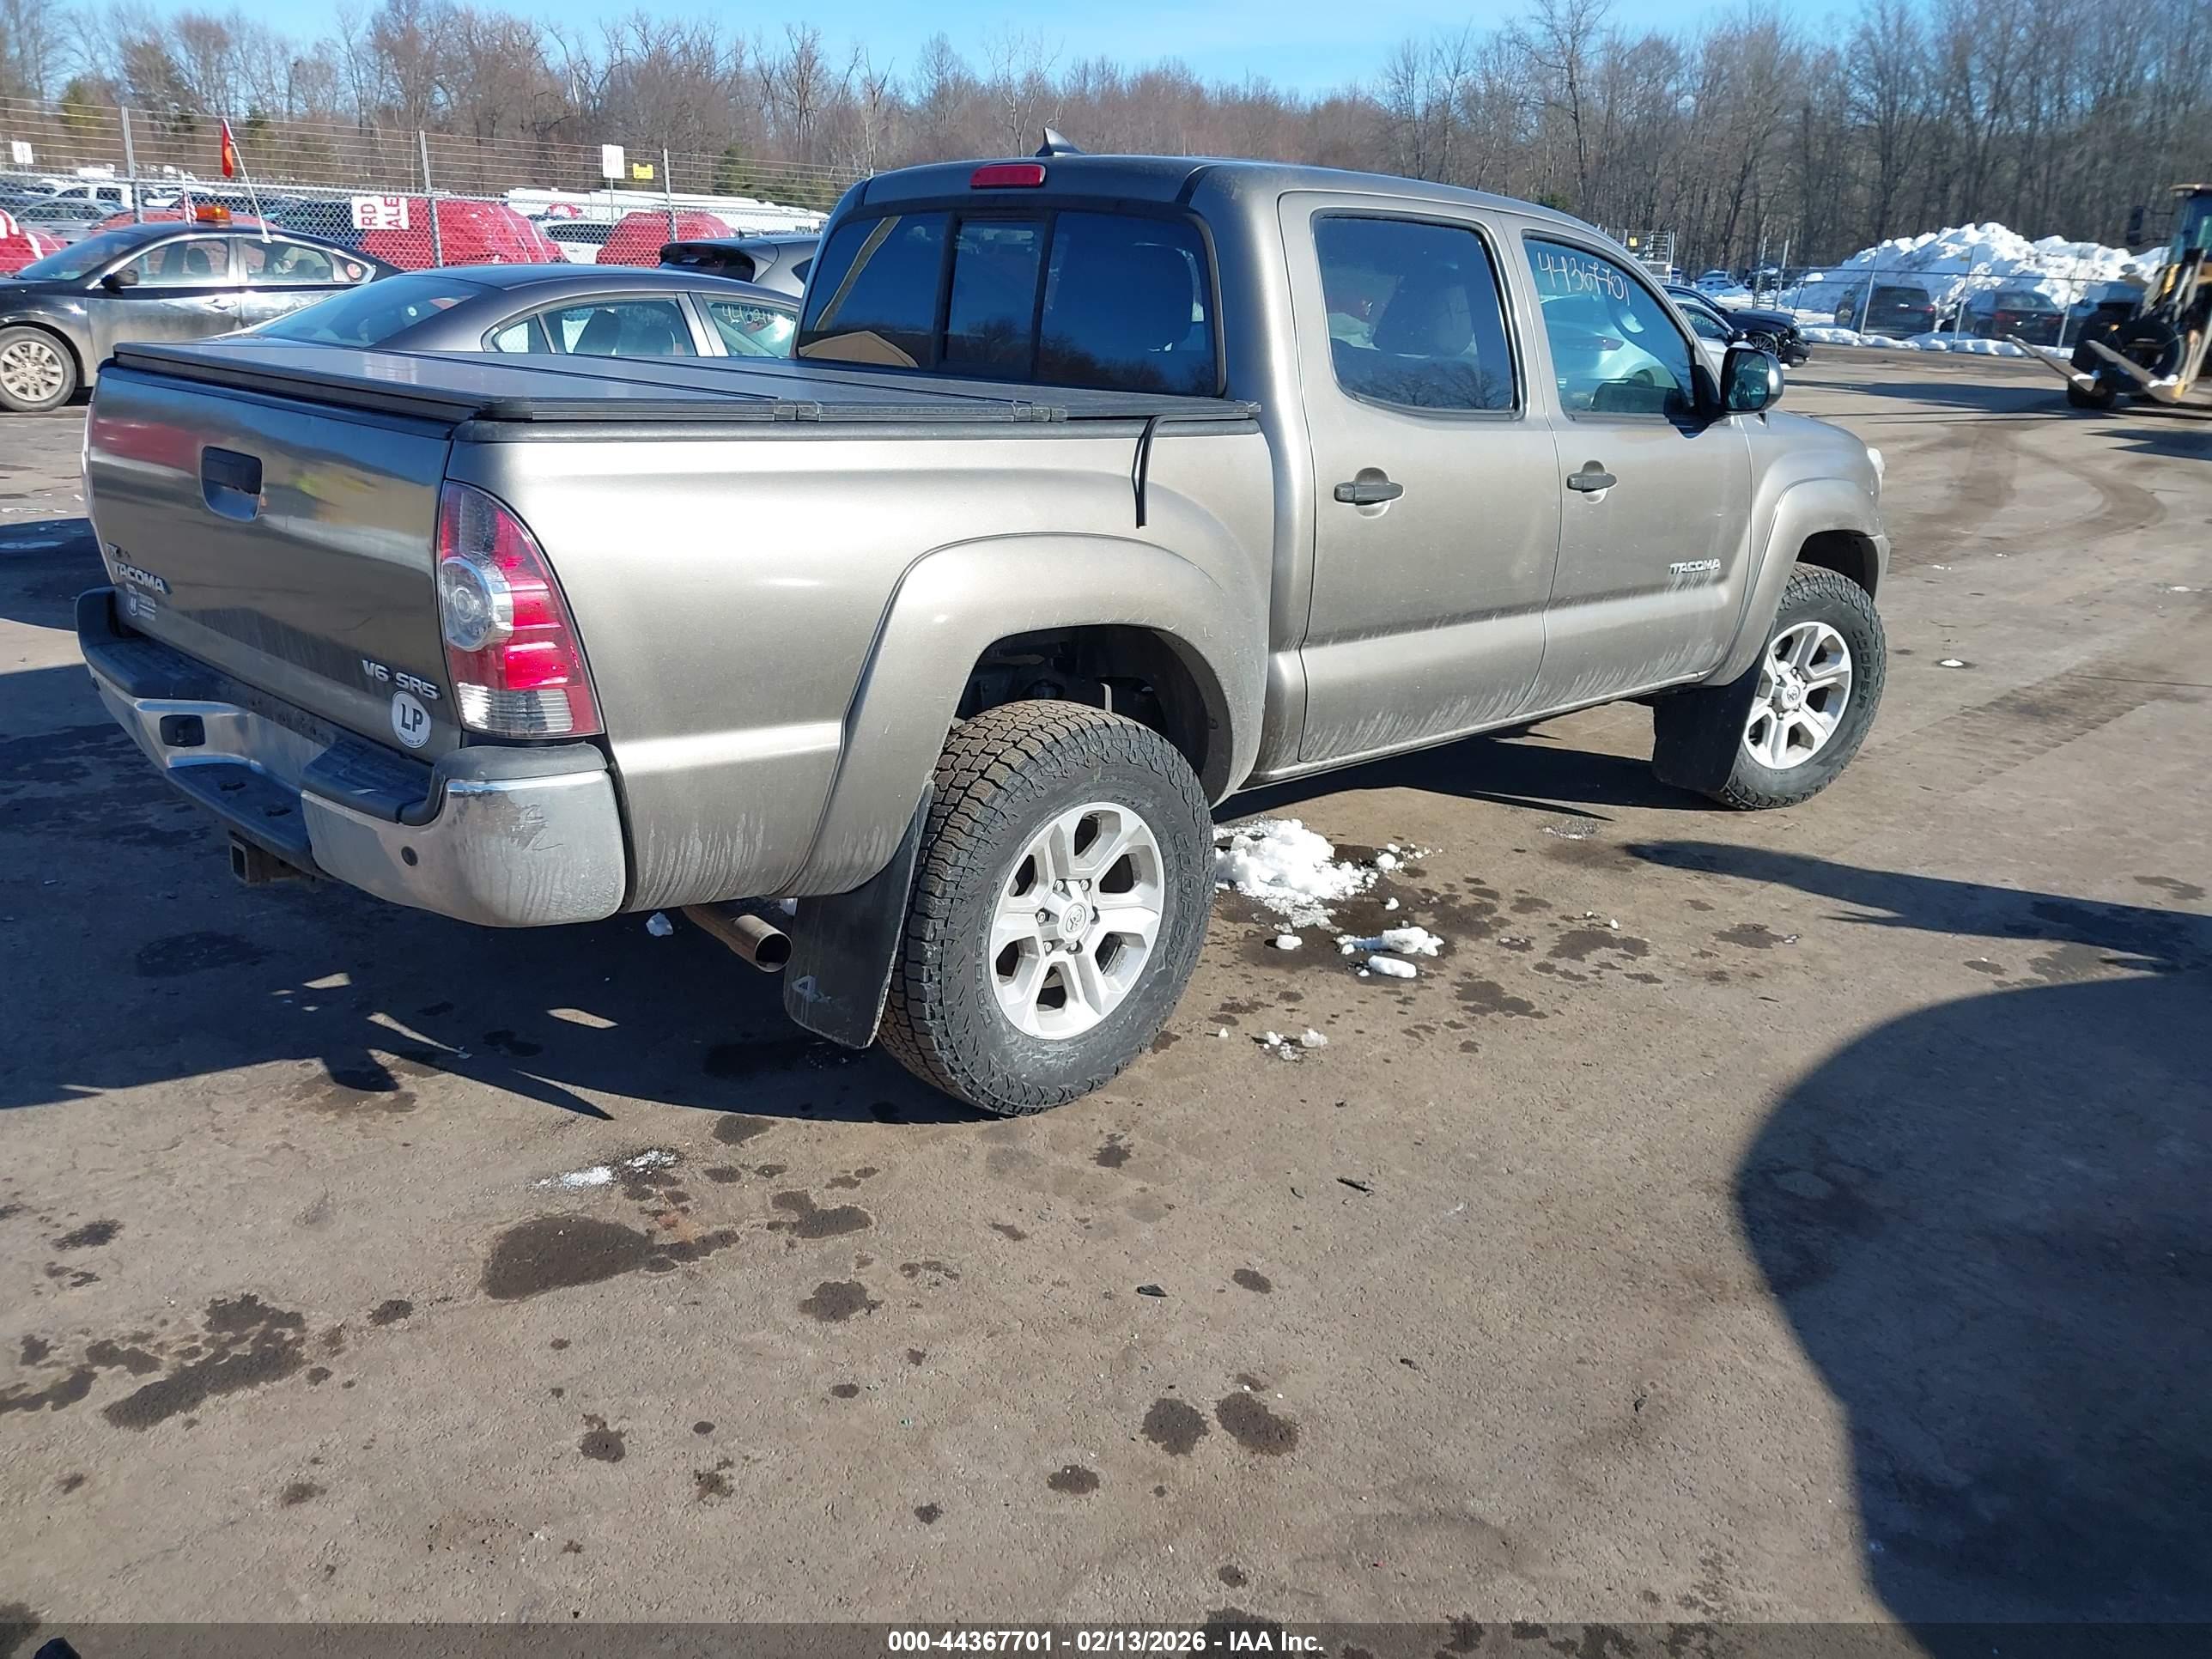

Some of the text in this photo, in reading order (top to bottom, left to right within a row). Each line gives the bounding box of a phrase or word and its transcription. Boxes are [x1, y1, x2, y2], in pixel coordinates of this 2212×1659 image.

[1537, 251, 1630, 307] 44367701
[112, 561, 167, 594] TACOMA
[1669, 558, 1722, 574] TACOMA
[362, 661, 441, 700] V6 SR5
[401, 702, 424, 732] LP
